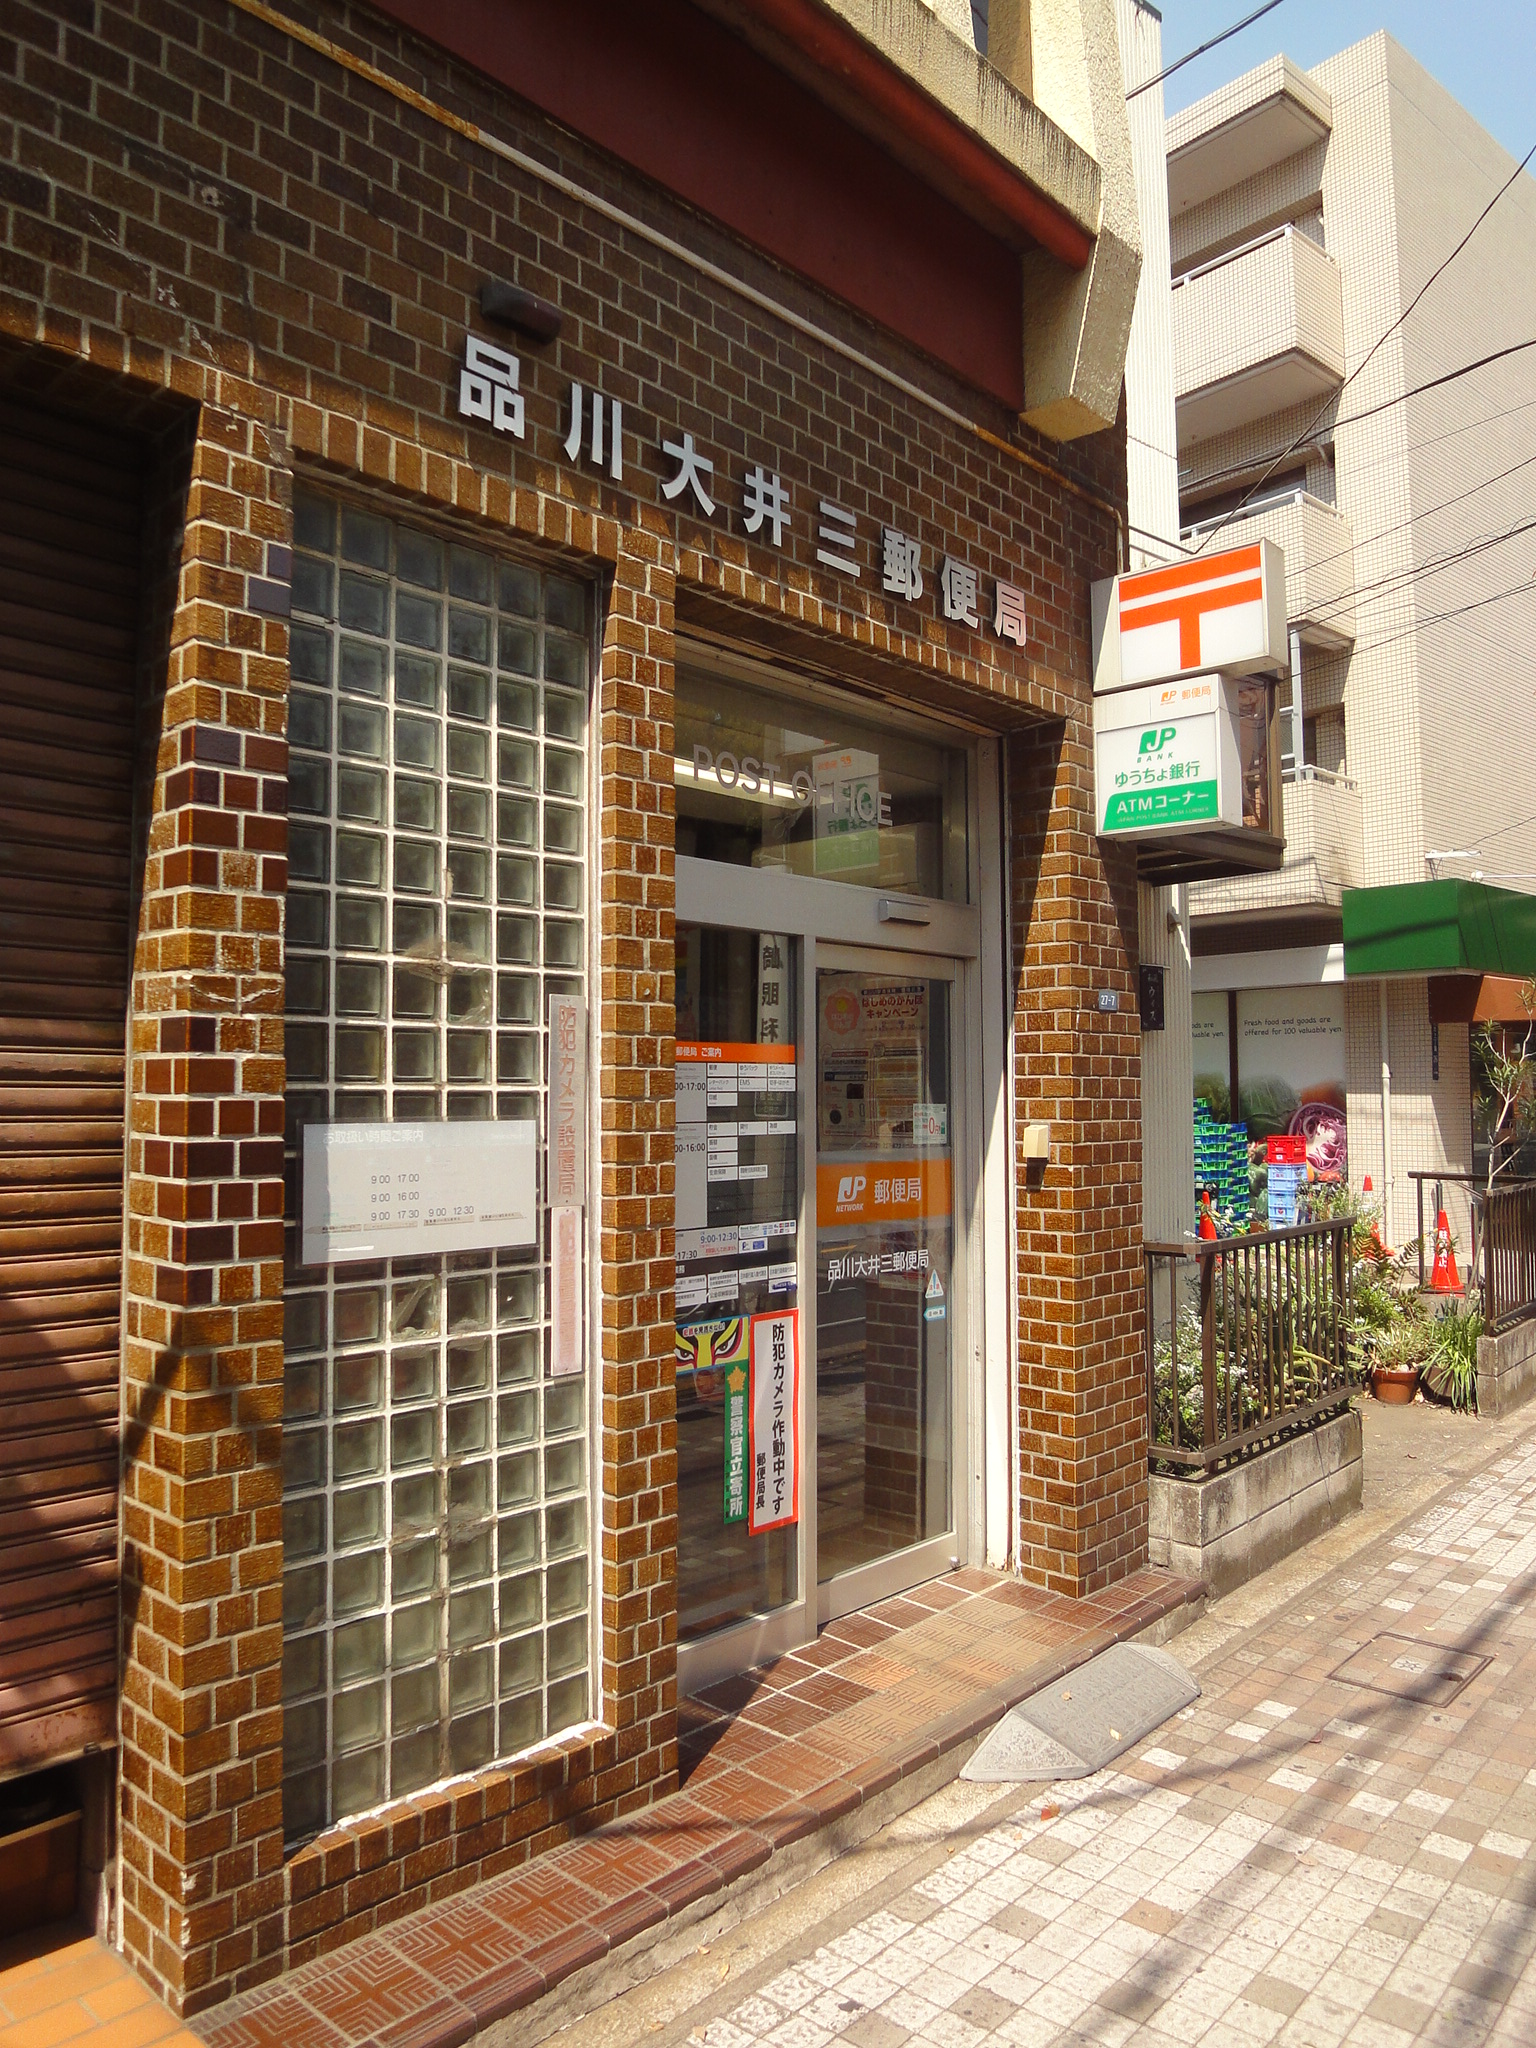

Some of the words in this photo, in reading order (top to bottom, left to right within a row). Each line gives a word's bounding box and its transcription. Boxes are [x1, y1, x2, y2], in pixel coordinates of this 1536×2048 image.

[459, 334, 1027, 647] 品川大井三郵便局
[1182, 685, 1211, 700] 郵便局
[1139, 727, 1176, 754] JP
[1137, 752, 1173, 763] BANK
[693, 744, 780, 799] POST
[1115, 760, 1200, 787] ゆうちょ銀行
[1117, 790, 1209, 814] ATMコーナー
[1100, 995, 1116, 1006] 27-7
[1297, 1016, 1316, 1026] goods
[701, 1048, 722, 1058] ご案内
[675, 1082, 706, 1091] 00-17:00
[675, 1143, 706, 1153] 00-16:00
[837, 1176, 866, 1202] JP
[874, 1178, 922, 1204] 郵便局
[836, 1203, 864, 1213] NETWORK
[701, 1233, 738, 1244] 9:00-12:30
[675, 1250, 698, 1259] -17:30
[828, 1249, 929, 1281] 品川大井三郵便局
[772, 1323, 785, 1515] 防犯カメラ作動中です
[730, 1395, 744, 1518] 警察官立寄所
[756, 1452, 766, 1510] 郵便局長
